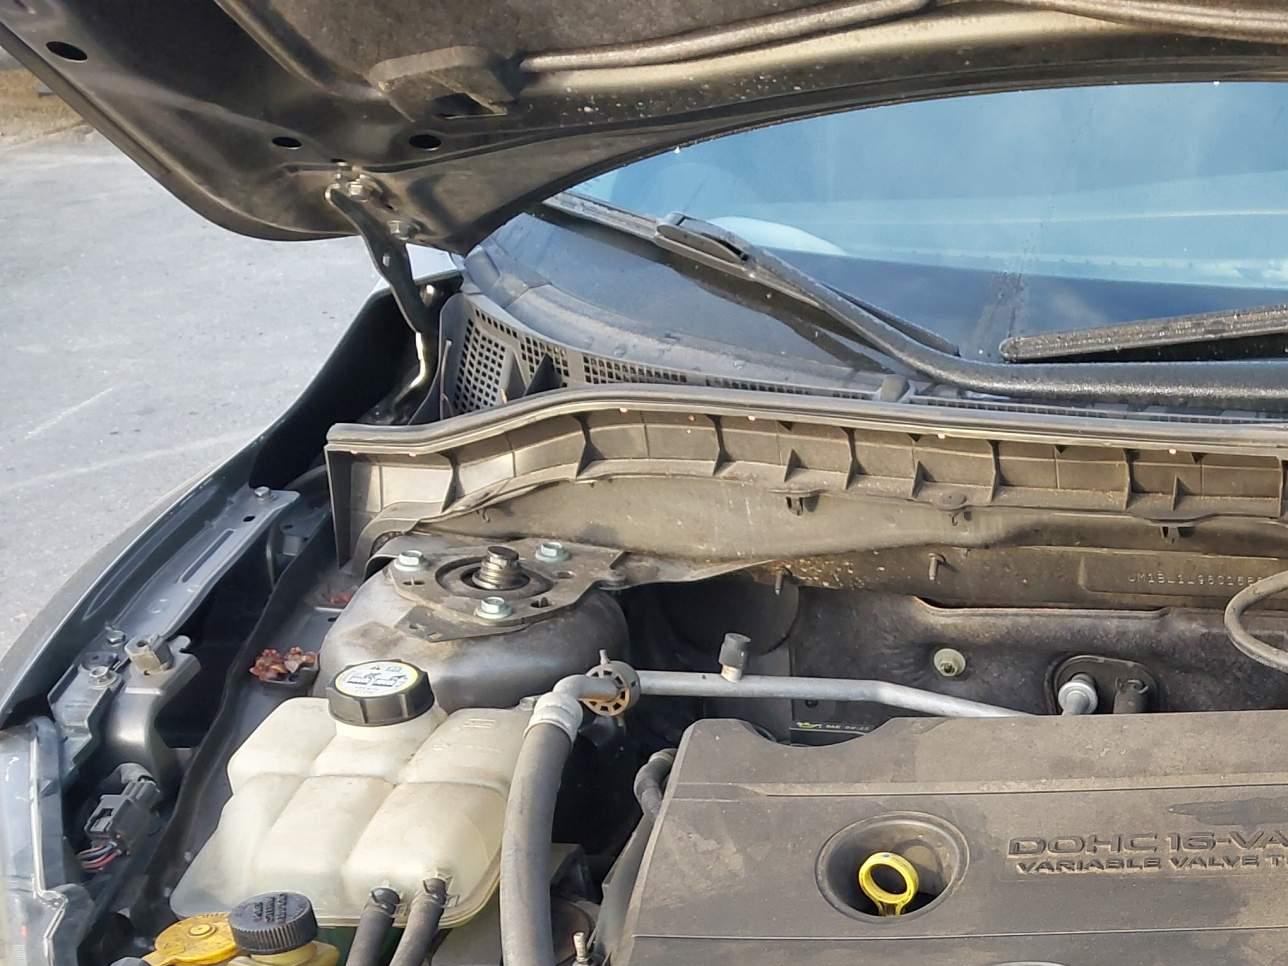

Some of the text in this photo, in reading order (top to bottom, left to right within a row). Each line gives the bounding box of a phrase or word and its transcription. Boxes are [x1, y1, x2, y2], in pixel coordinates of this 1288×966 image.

[1007, 833, 1158, 858] DOHC
[1015, 856, 1161, 873] VARIABLE
[1168, 853, 1260, 870] VALVE
